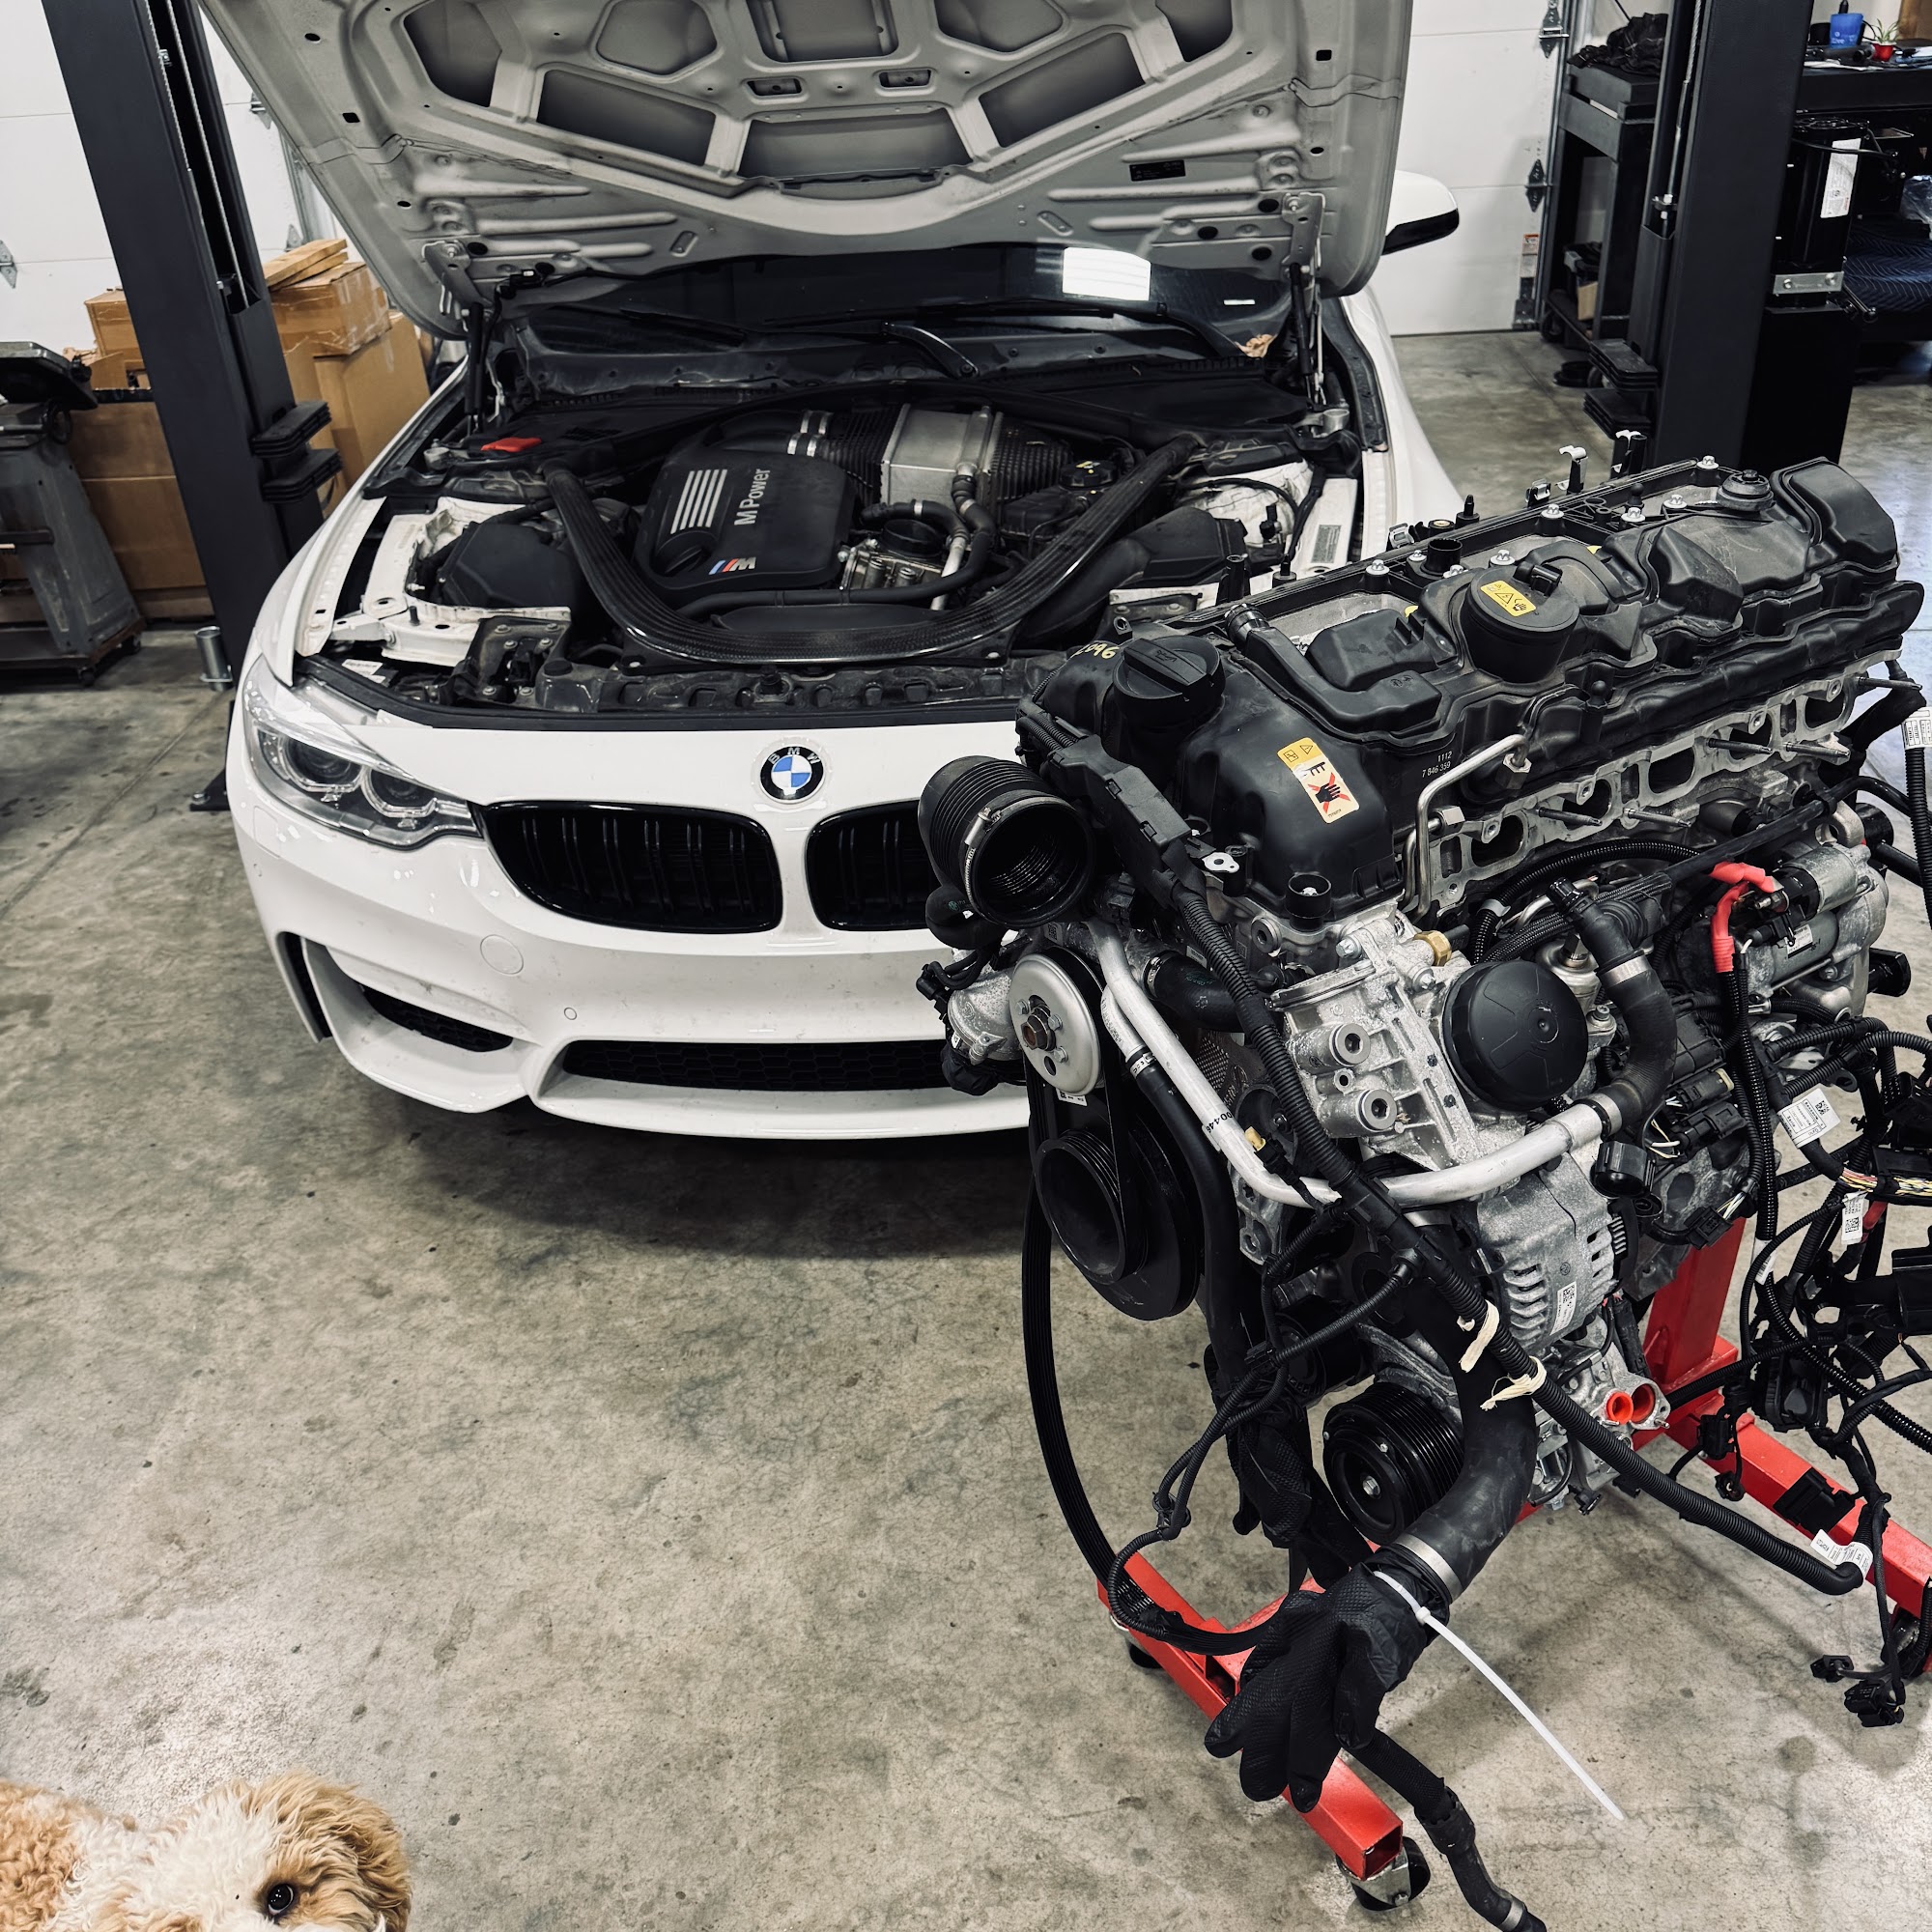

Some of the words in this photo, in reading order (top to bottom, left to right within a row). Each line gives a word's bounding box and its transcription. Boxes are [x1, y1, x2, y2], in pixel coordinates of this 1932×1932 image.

[768, 747, 821, 765] BMW
[1437, 751, 1453, 762] 1112
[1427, 765, 1439, 777] 846
